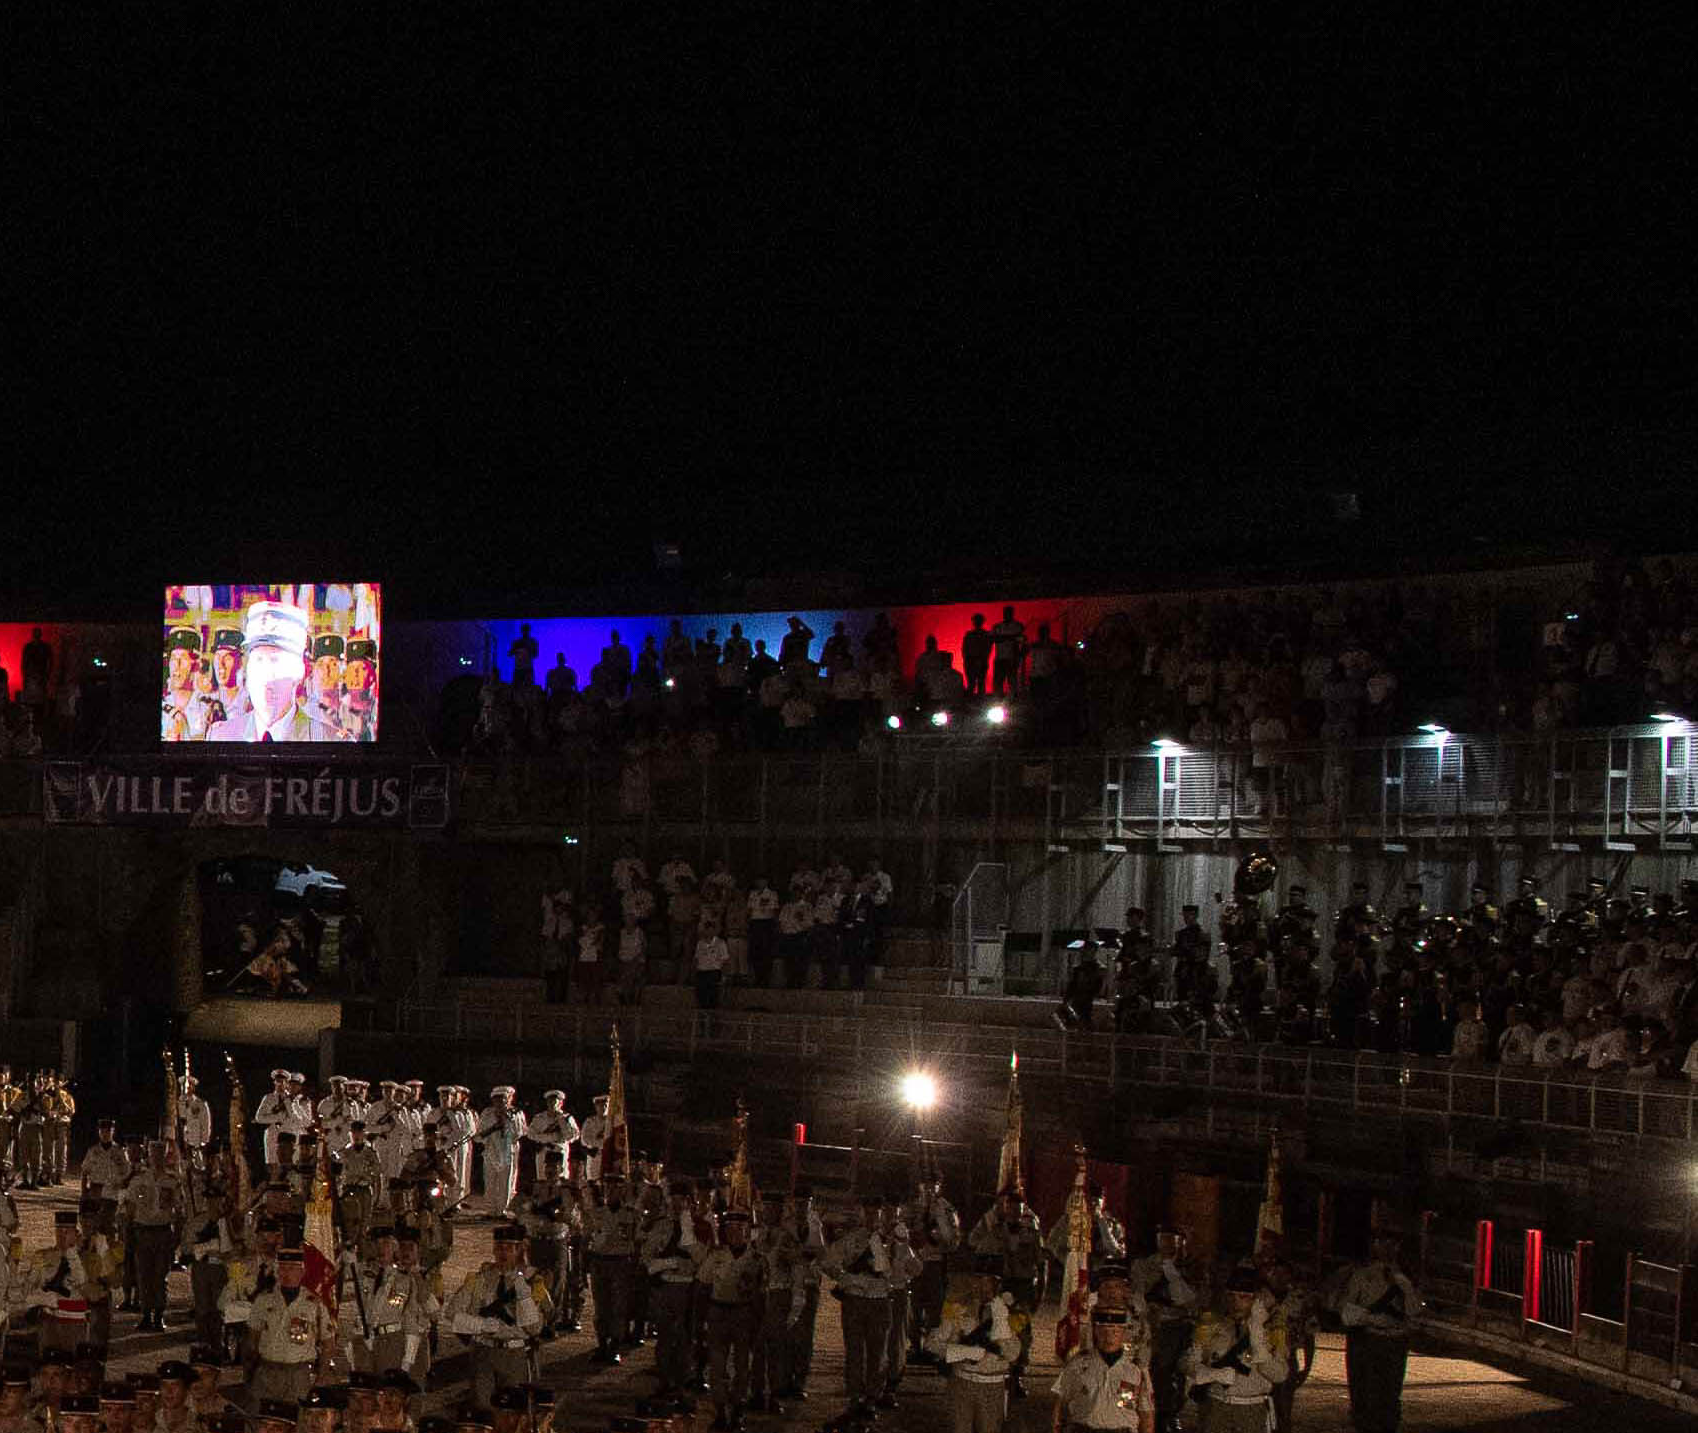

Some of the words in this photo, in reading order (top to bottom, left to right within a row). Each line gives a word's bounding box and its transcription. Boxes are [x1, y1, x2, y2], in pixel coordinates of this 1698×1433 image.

[87, 774, 193, 815] VILLE
[205, 773, 251, 815] de
[264, 766, 401, 824] FRÉJUS
